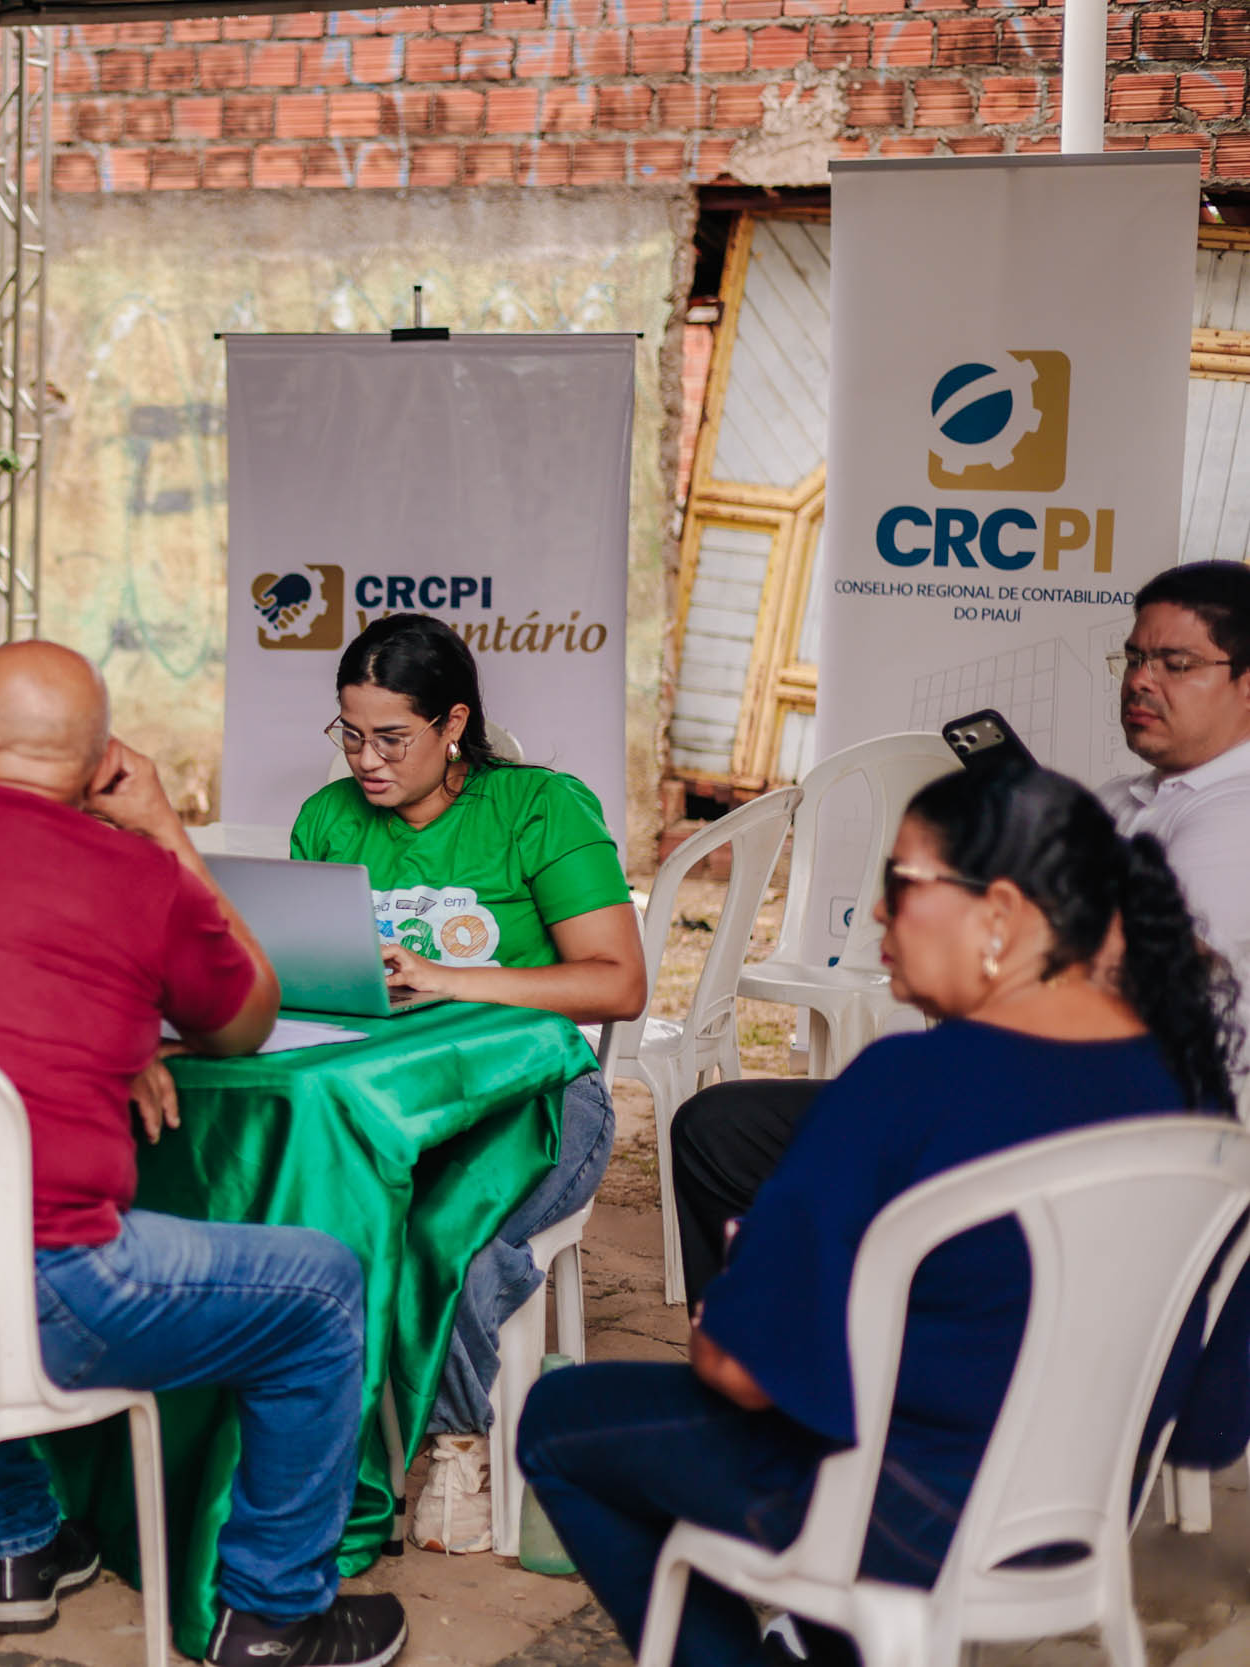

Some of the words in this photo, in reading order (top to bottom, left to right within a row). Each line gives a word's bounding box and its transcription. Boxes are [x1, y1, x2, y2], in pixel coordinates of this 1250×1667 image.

[876, 506, 1115, 573] CRCPI
[355, 575, 493, 610] CRCPI
[835, 580, 913, 596] CONSELHO
[917, 583, 993, 600] REGIONAL
[999, 586, 1018, 600] DE
[1022, 587, 1136, 605] CONTABILIDAD
[954, 607, 977, 620] DO
[981, 606, 1021, 622] PIAUÍ
[356, 610, 607, 653] ntário
[444, 896, 467, 908] em
